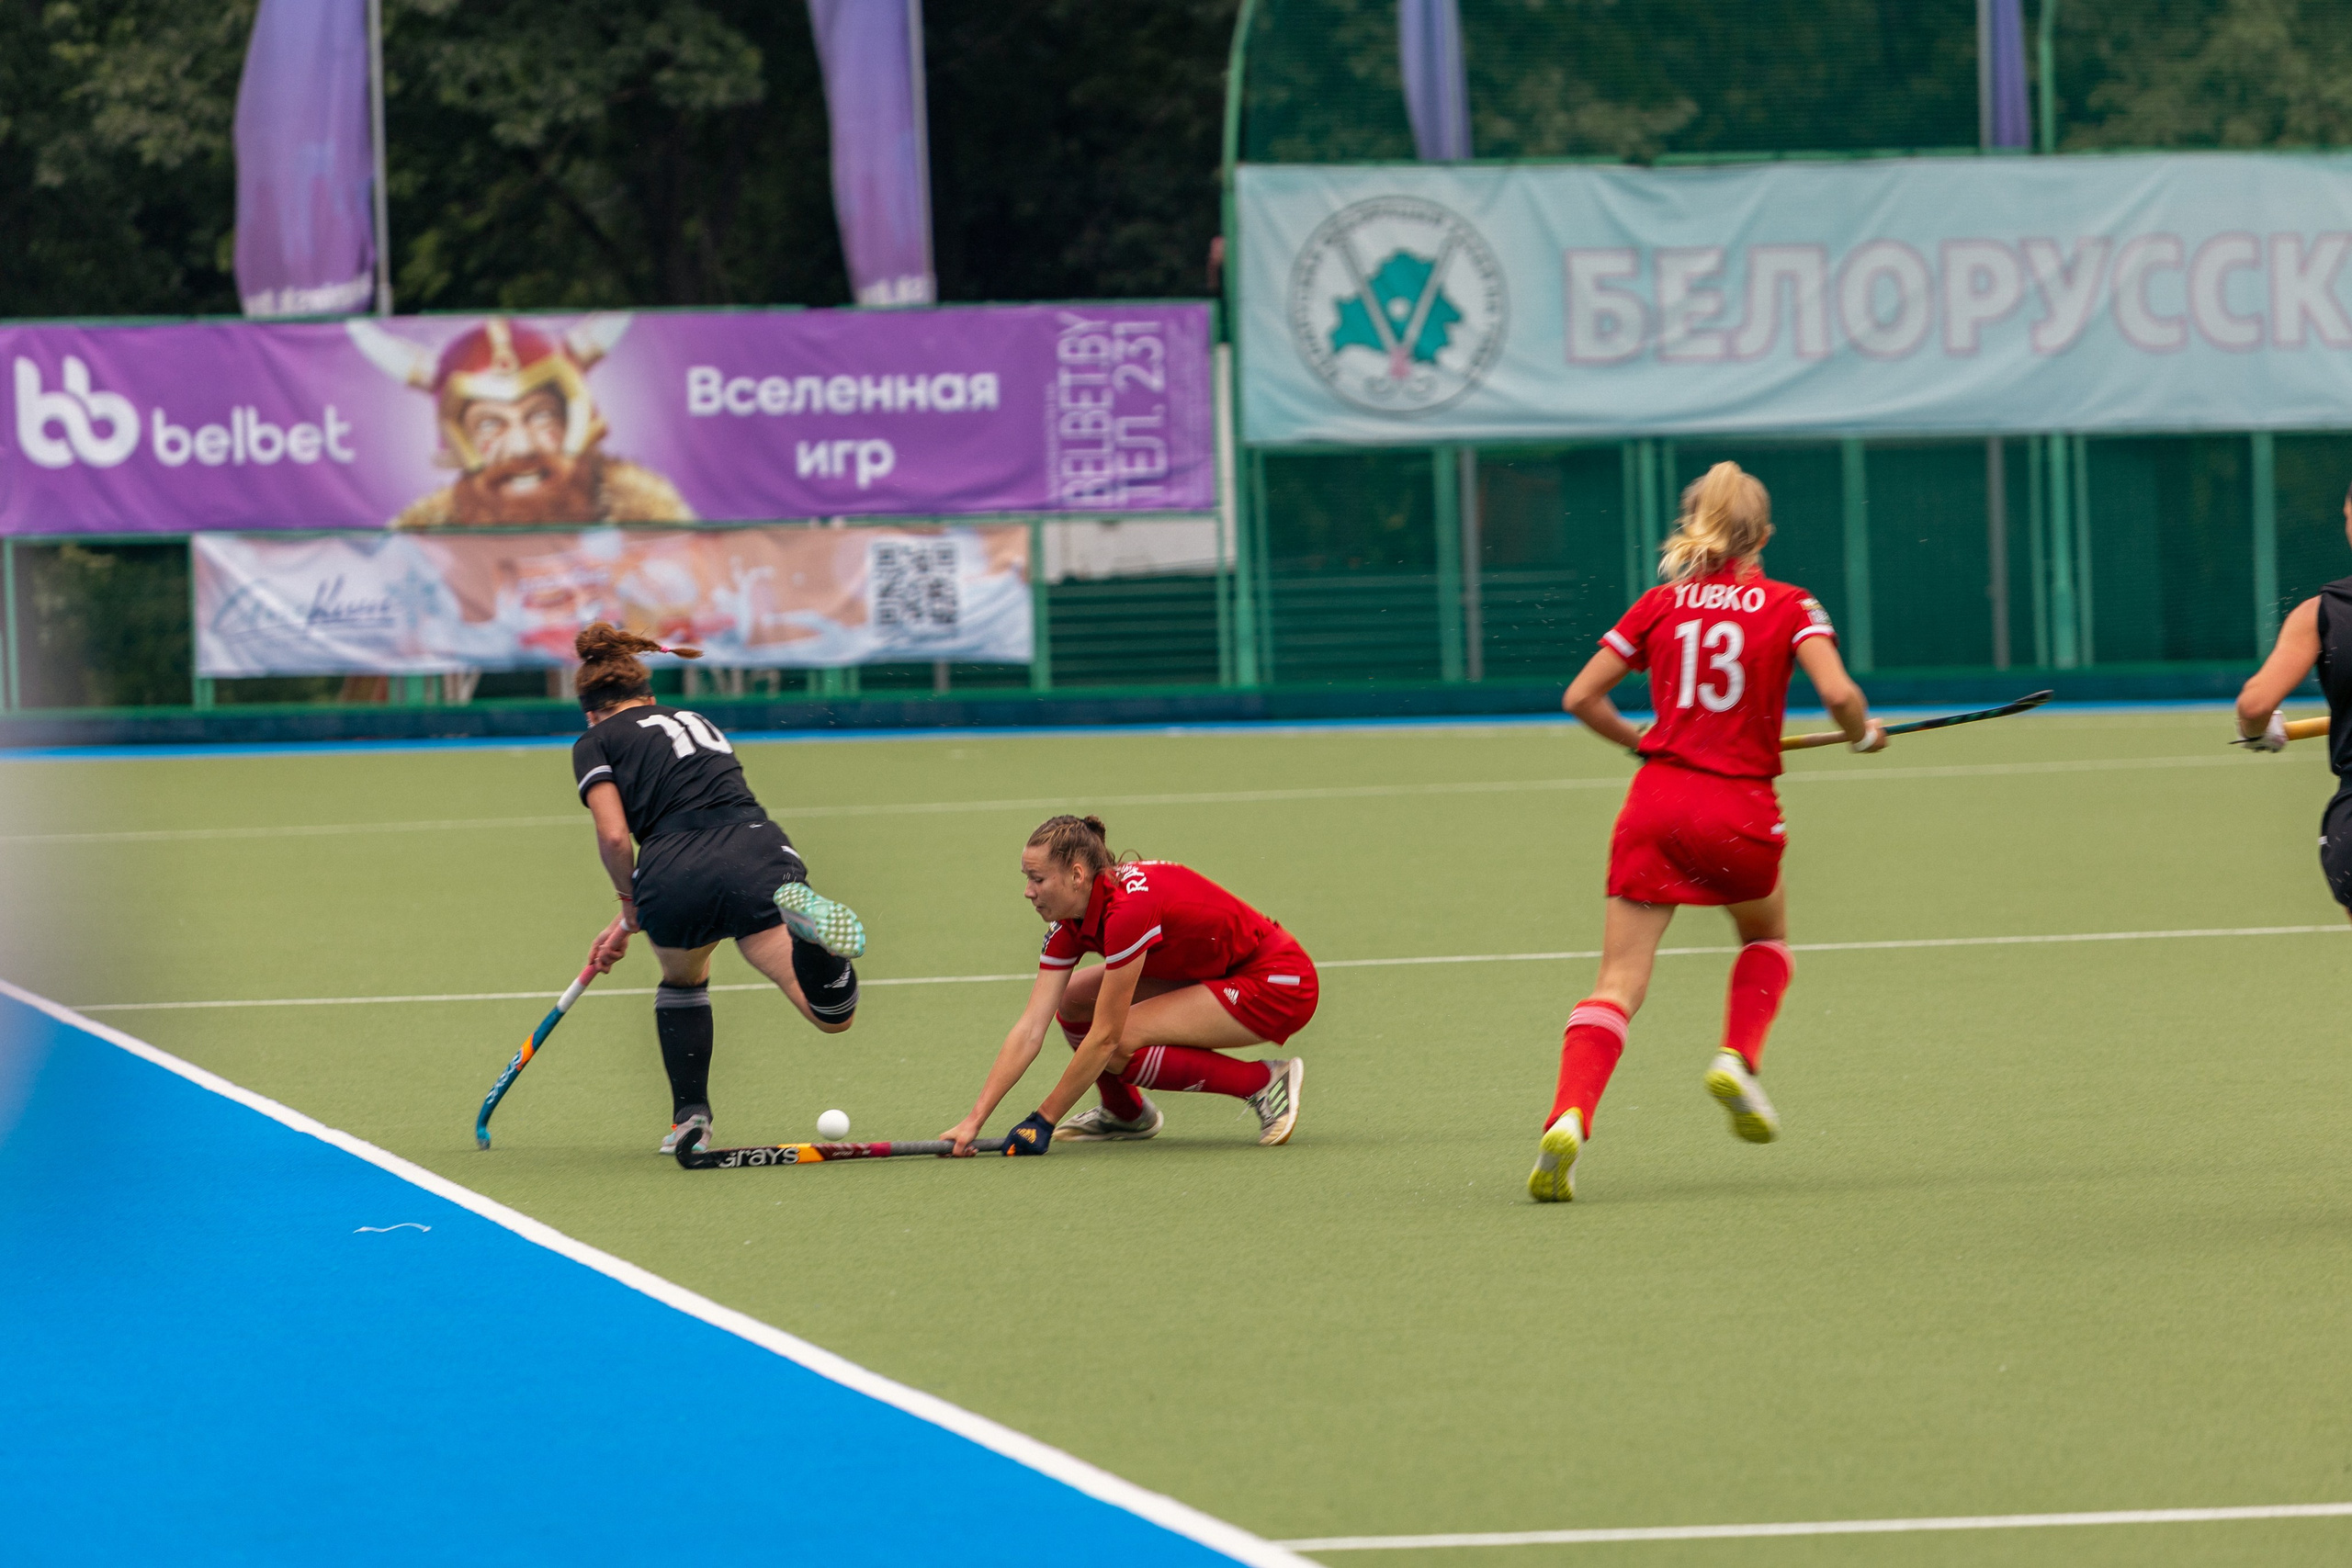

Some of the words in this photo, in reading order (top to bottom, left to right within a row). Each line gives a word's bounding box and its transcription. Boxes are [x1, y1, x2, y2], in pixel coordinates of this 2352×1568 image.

[1563, 231, 2352, 365] БЕЛОРУССК
[1112, 321, 1165, 394] 231
[685, 366, 1000, 416] Вселенная
[152, 403, 356, 467] belbet
[796, 438, 896, 490] игр
[1674, 581, 1766, 614] YUBKO
[1673, 617, 1747, 713] 13
[636, 710, 734, 760] 10
